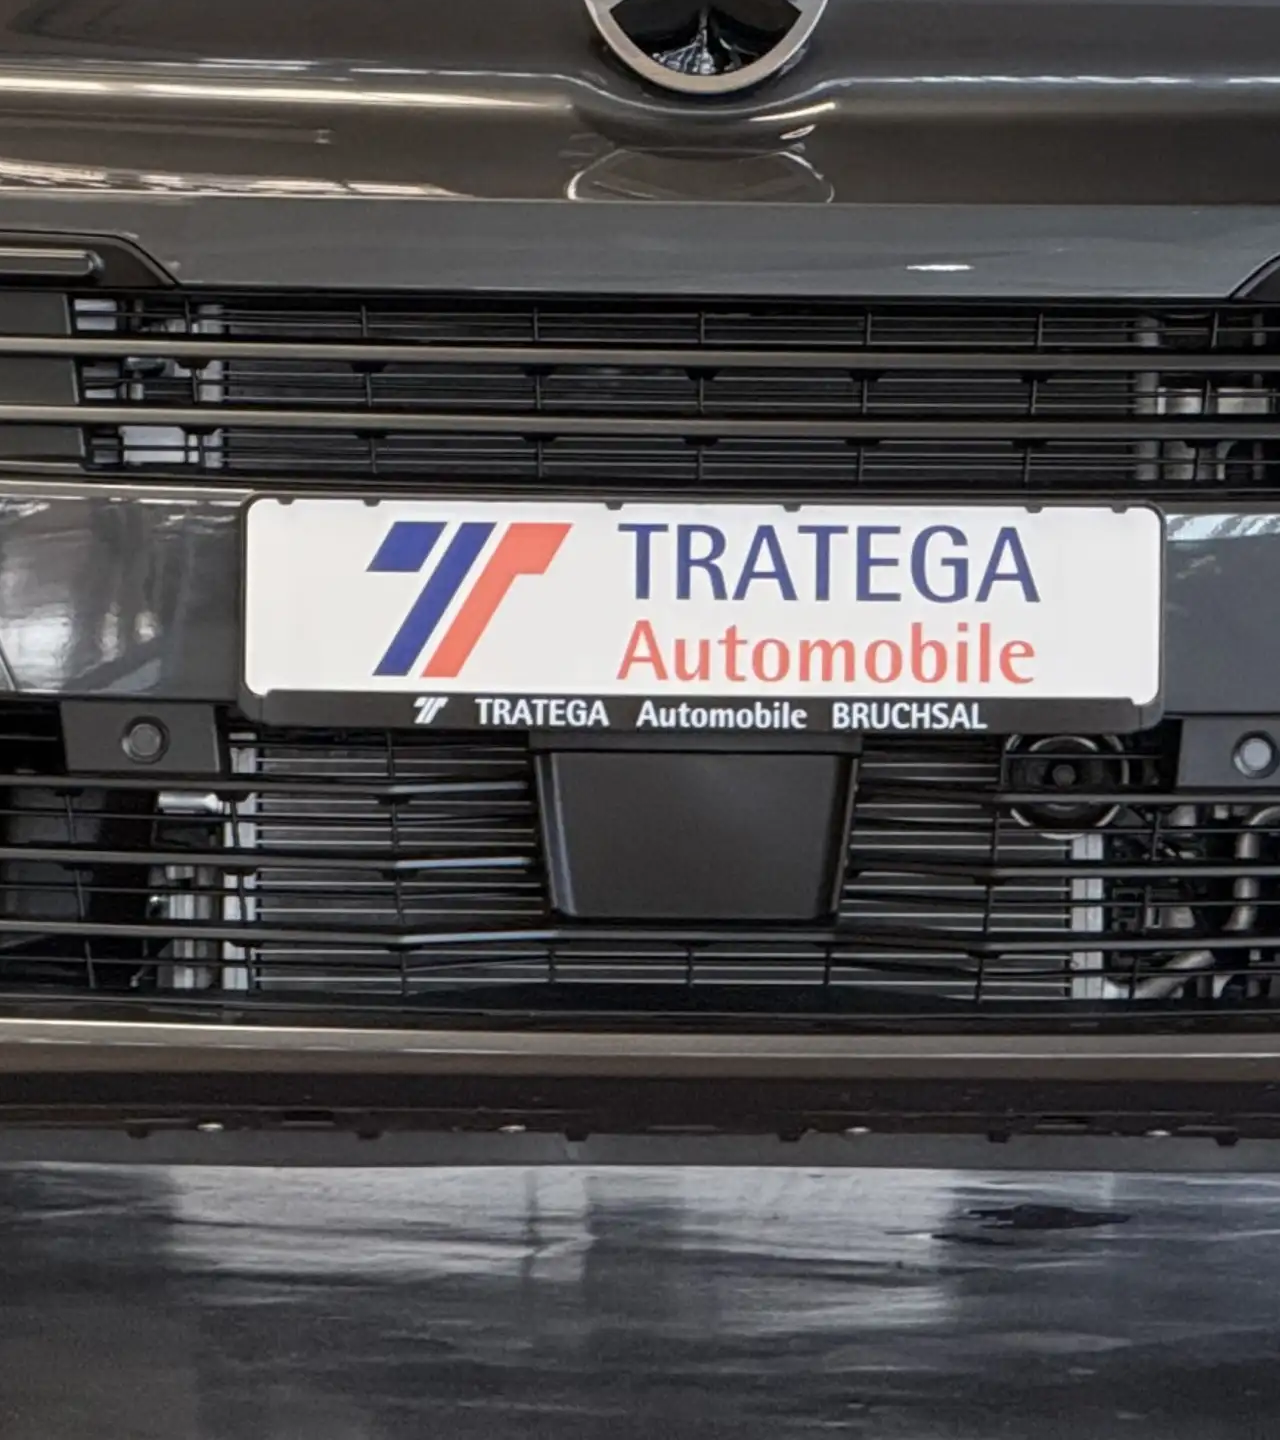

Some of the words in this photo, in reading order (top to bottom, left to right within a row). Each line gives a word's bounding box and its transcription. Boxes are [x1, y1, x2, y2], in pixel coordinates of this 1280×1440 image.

[618, 522, 1041, 604] TRATEGA
[616, 619, 1036, 685] Automobile
[474, 697, 610, 728] TRATEGA
[635, 699, 808, 729] Automobile
[831, 701, 988, 731] BRUCHSAL
